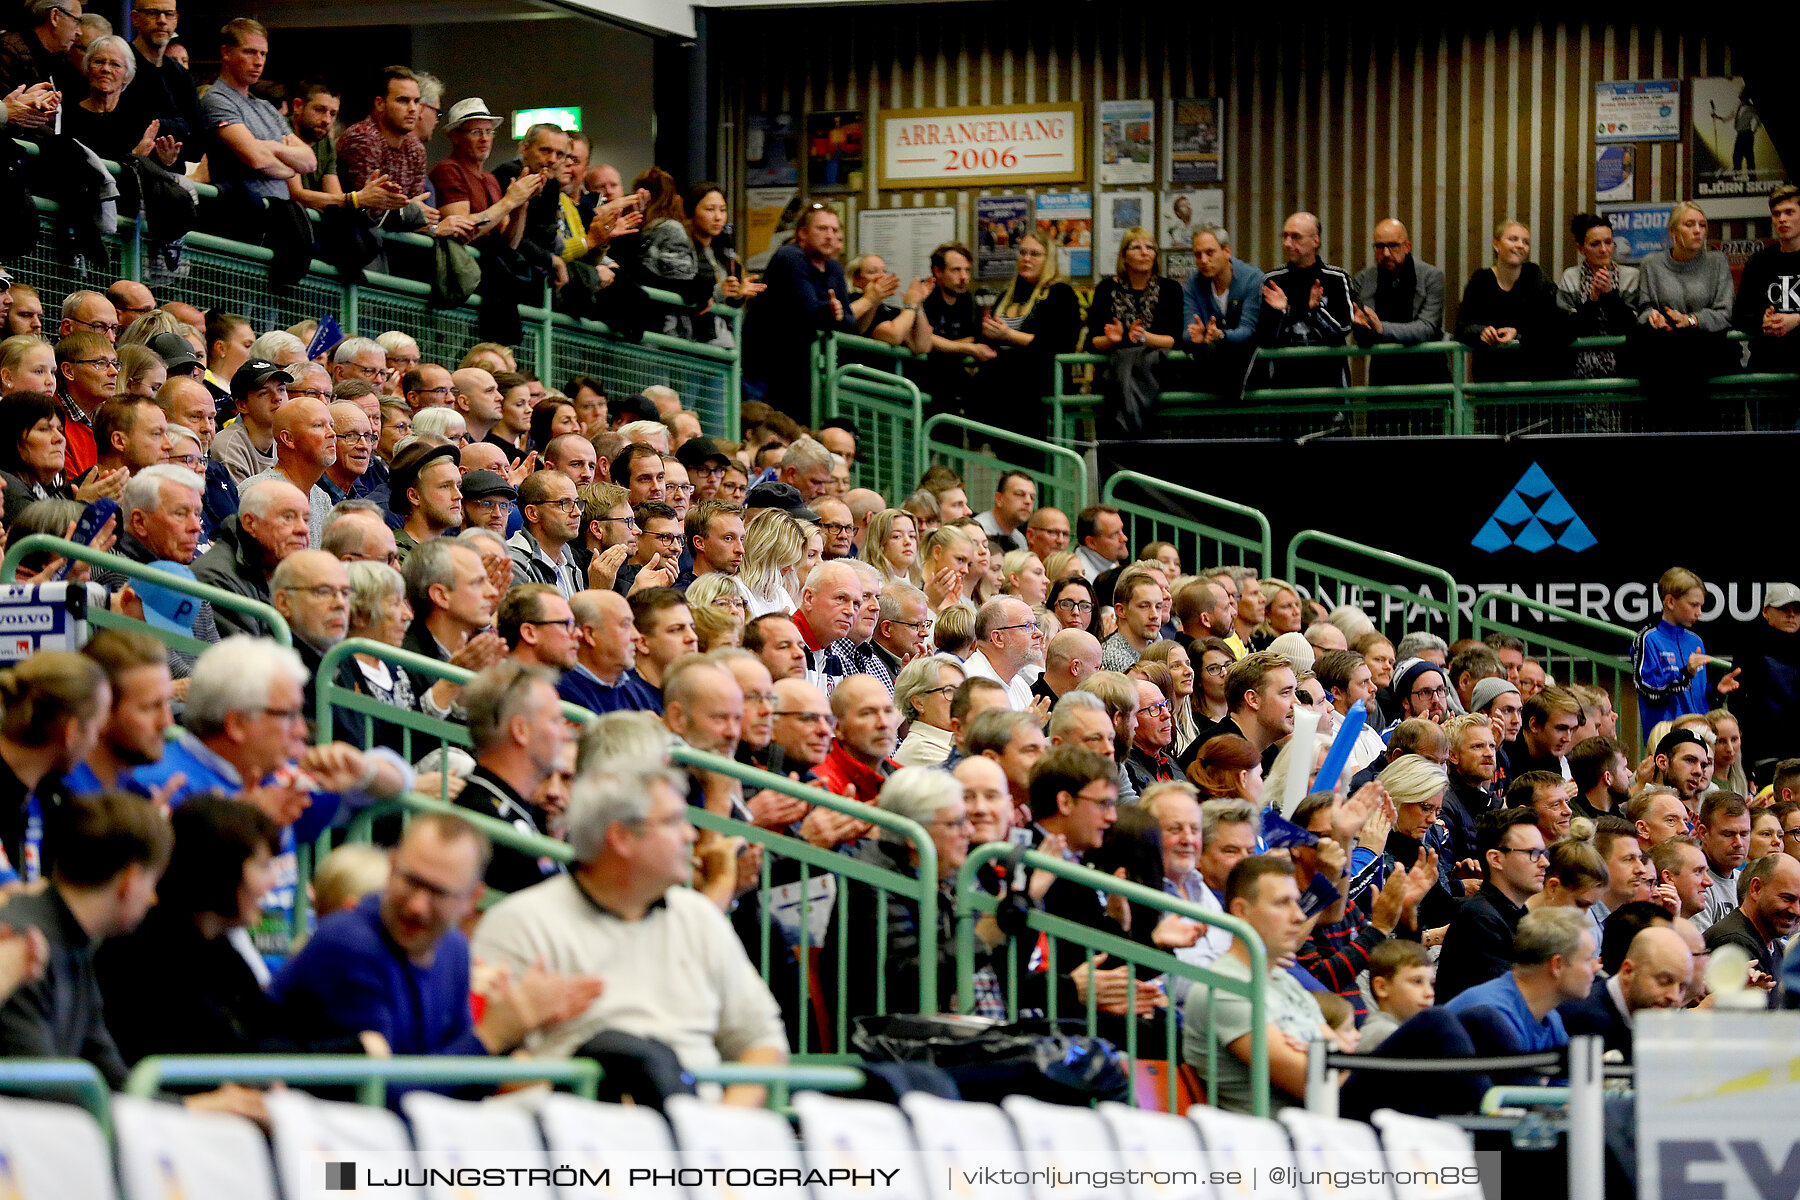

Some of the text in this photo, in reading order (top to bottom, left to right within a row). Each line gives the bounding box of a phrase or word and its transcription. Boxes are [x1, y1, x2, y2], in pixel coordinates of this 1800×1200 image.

[895, 117, 1065, 147] ARRANGEMANG
[943, 147, 1018, 171] 2006
[1698, 179, 1744, 195] BJÖRN
[1633, 212, 1671, 230] 2007
